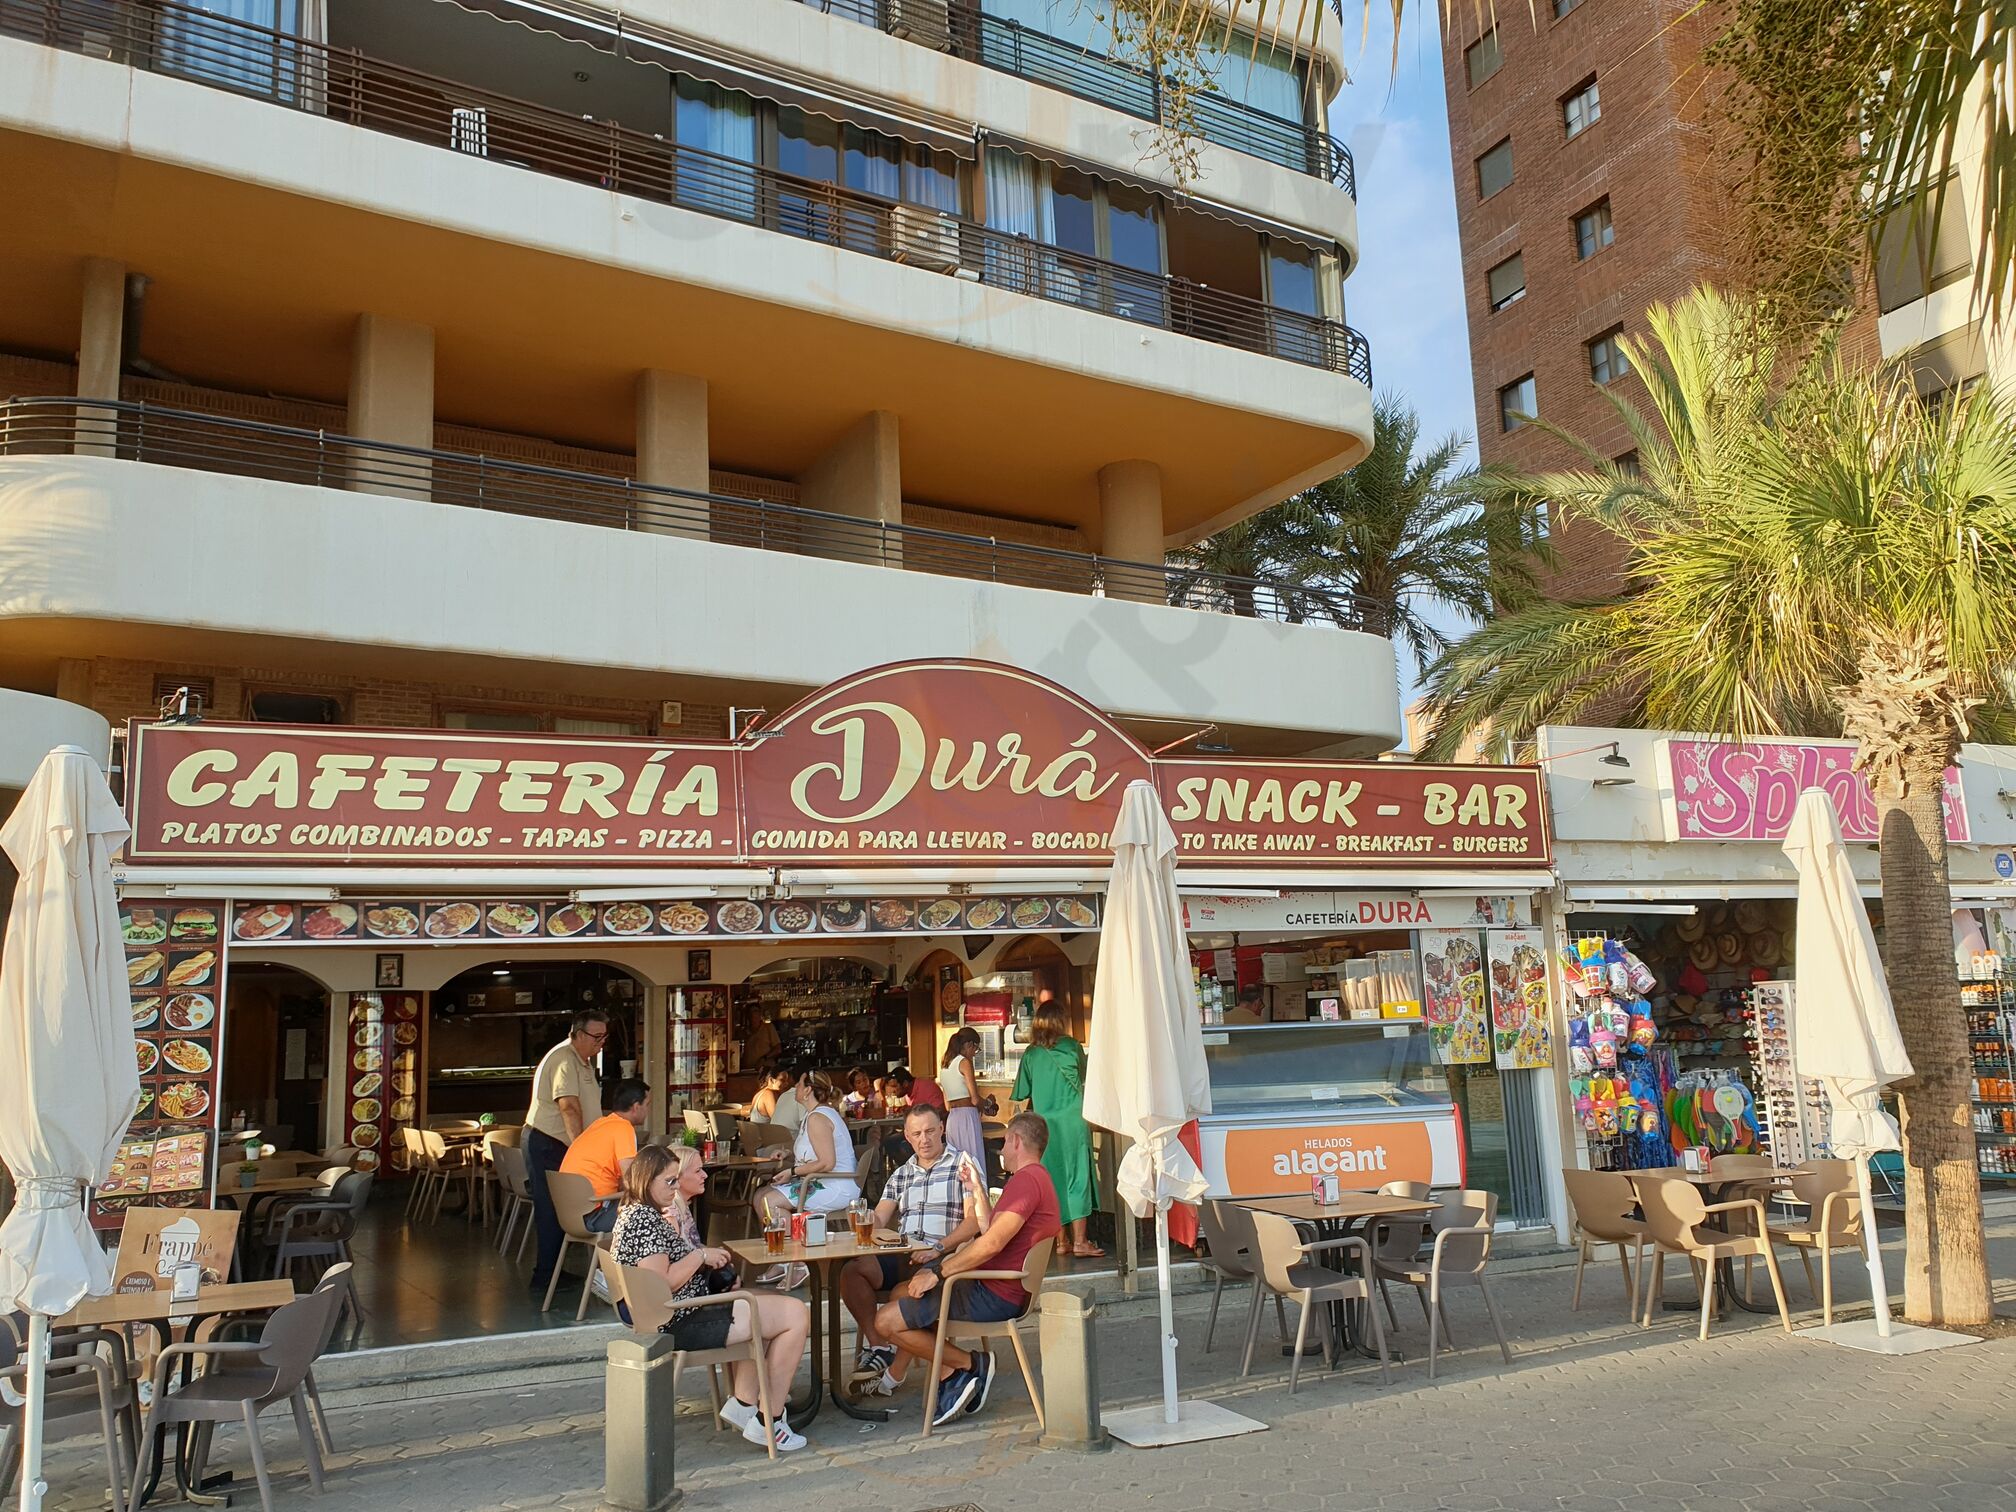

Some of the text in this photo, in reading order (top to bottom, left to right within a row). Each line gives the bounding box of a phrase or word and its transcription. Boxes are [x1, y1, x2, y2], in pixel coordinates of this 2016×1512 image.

[789, 701, 1120, 824] Durá
[166, 749, 719, 819] CAFETERÍA
[1695, 742, 1880, 839] Splas
[1170, 776, 1363, 829] SNACK
[1423, 782, 1528, 830] BAR
[160, 821, 283, 846] PLATOS
[289, 823, 493, 848] COMBINADOS
[521, 827, 609, 849] TAPAS
[637, 827, 713, 849] PIZZA
[751, 829, 850, 849] COMIDA
[857, 830, 919, 850] PARA
[926, 830, 1007, 851] LLEVAR
[1031, 831, 1110, 850] BOCADI
[1181, 832, 1206, 850] TO
[1211, 833, 1258, 851] TAKE
[1263, 834, 1317, 851] AWAY
[1335, 834, 1435, 853] BREAKFAST
[1452, 835, 1529, 854] BURGERS
[1285, 910, 1358, 926] CAFETERÍA
[1304, 1137, 1353, 1149] HELADOS
[154, 1258, 175, 1275] Ca
